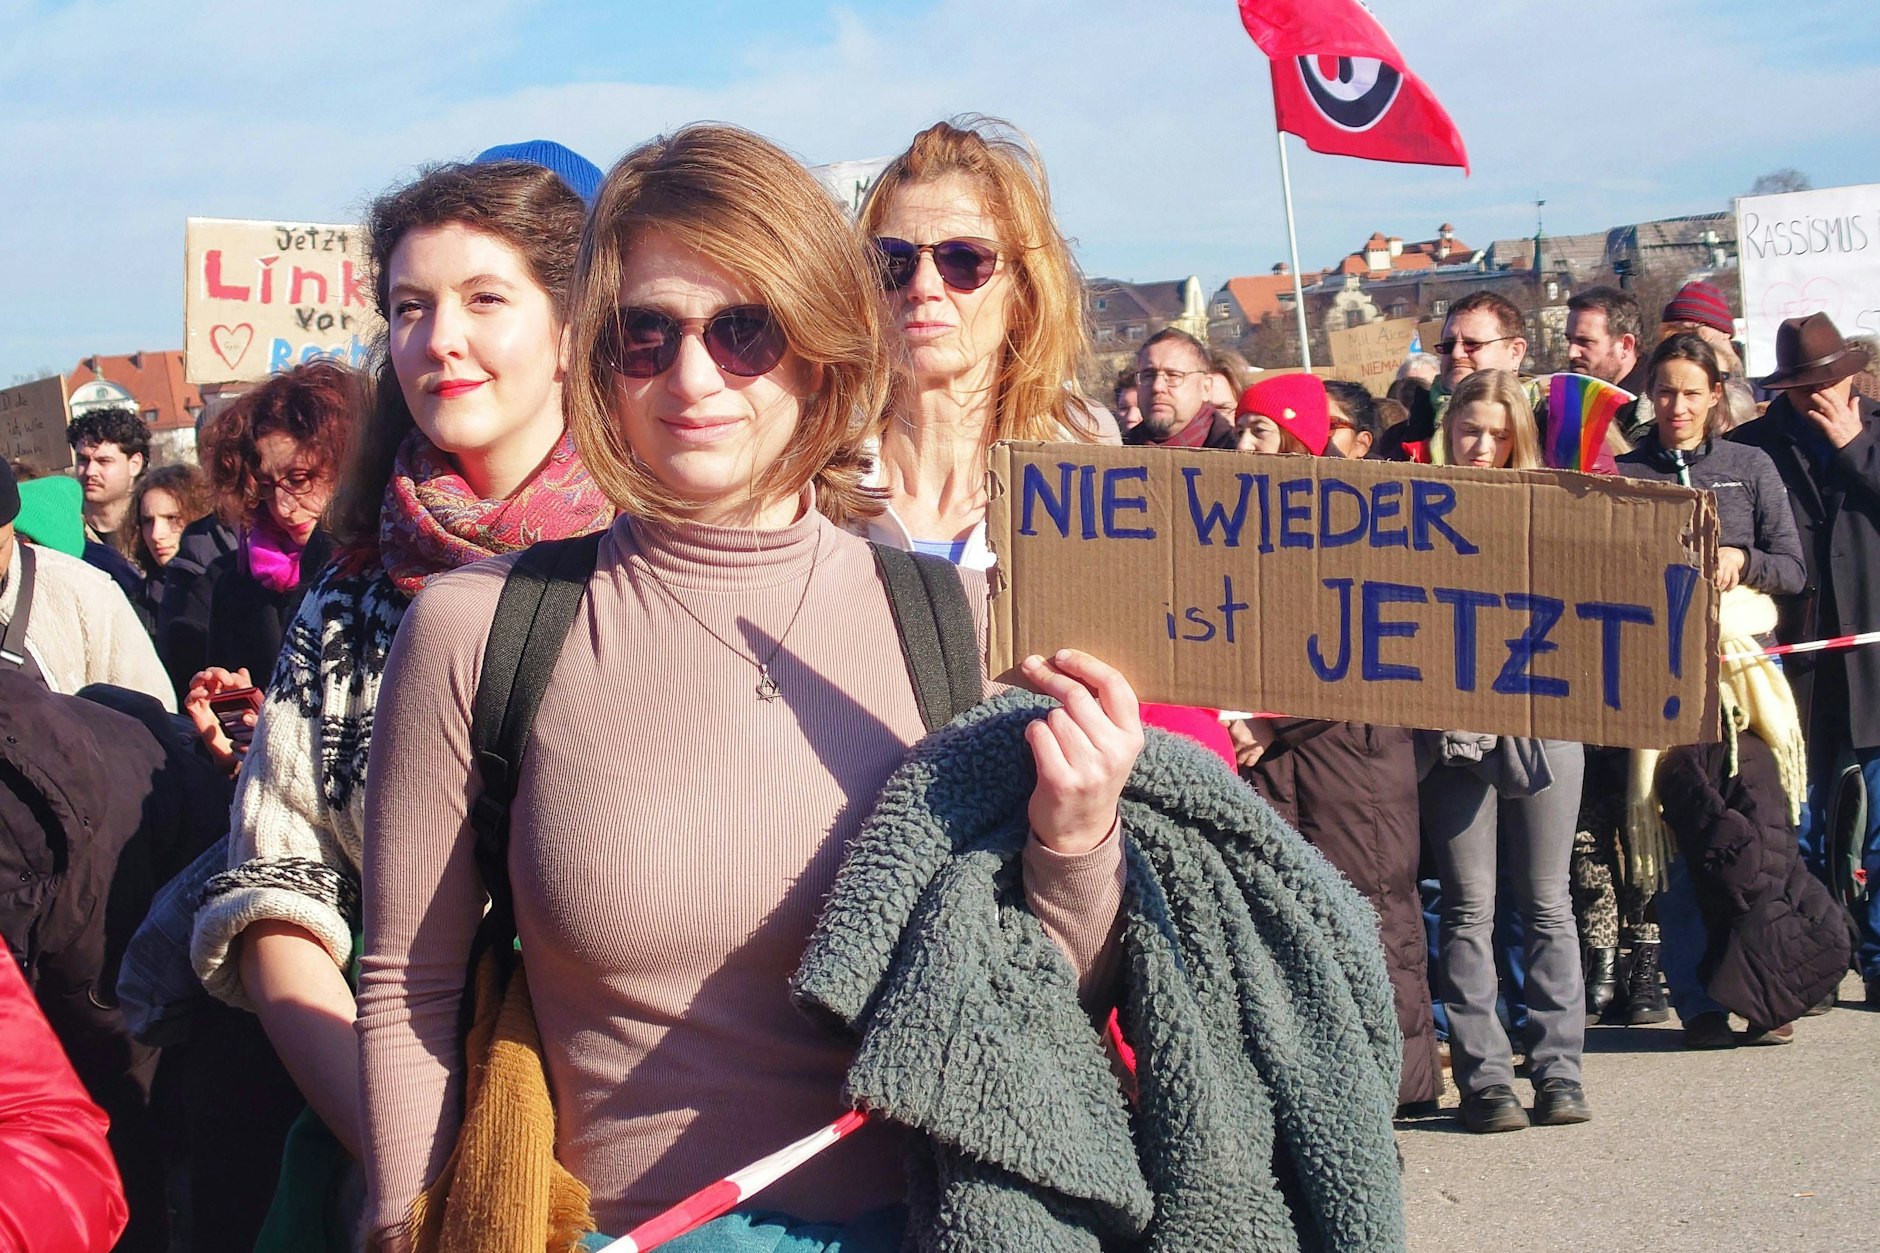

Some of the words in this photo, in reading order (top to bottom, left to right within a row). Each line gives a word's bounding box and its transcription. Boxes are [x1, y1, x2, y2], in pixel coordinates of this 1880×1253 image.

[276, 226, 349, 252] Jetzt
[1017, 463, 1156, 540] NIE
[1181, 466, 1479, 555] WIEDER
[1162, 575, 1249, 644] ist
[1307, 563, 1699, 720] JETZT!
